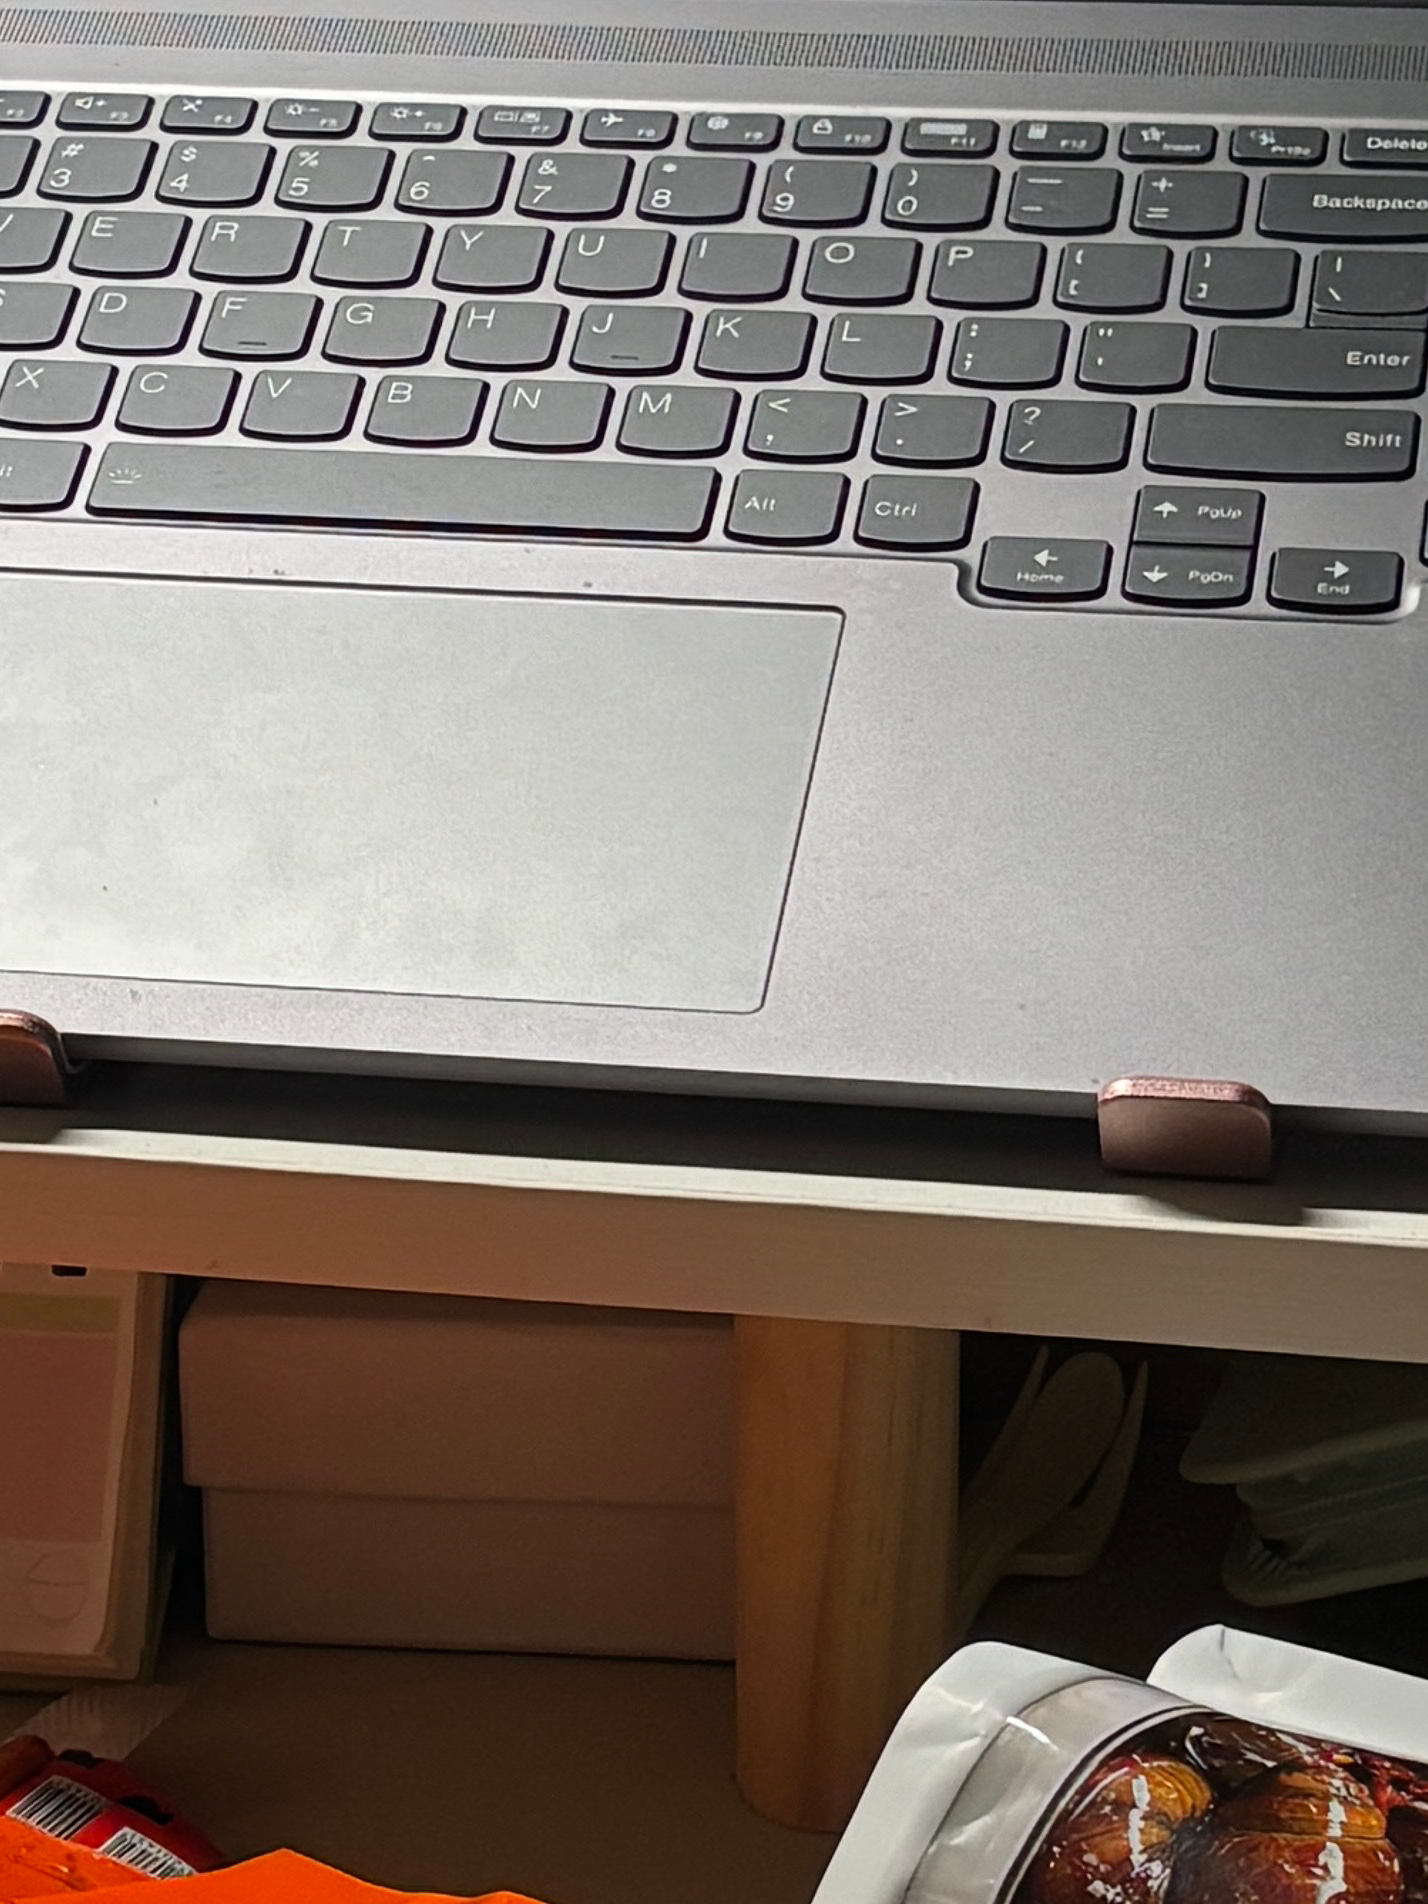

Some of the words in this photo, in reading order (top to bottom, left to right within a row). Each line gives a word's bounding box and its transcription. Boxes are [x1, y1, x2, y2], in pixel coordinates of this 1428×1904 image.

[1367, 137, 1427, 150] Delete
[46, 169, 71, 191] 3
[168, 171, 191, 192] 4
[285, 178, 309, 200] 5
[406, 182, 429, 204] 6
[528, 185, 552, 208] 7
[646, 189, 671, 212] 8
[1313, 195, 1428, 210] Backspace
[770, 193, 794, 216] 9
[897, 196, 917, 215] 0
[92, 217, 118, 236] E
[211, 222, 239, 241] R
[339, 227, 361, 246] T
[461, 231, 483, 250] Y
[579, 235, 604, 256] U
[700, 238, 707, 258] I
[825, 243, 854, 263] O
[948, 246, 973, 266] P
[99, 293, 126, 312] D
[222, 298, 247, 317] F
[346, 303, 374, 324] G
[468, 308, 495, 328] H
[593, 313, 613, 333] J
[716, 317, 741, 337] K
[842, 321, 860, 341] L
[1347, 352, 1410, 365] Enter
[16, 367, 44, 388] X
[140, 372, 167, 393] C
[268, 378, 291, 397] V
[388, 382, 412, 403] B
[513, 387, 540, 408] N
[639, 392, 671, 413] M
[1346, 432, 1400, 447] Shift
[745, 497, 775, 510] Alt
[875, 502, 916, 516] Ctrl
[1318, 583, 1349, 594] End
